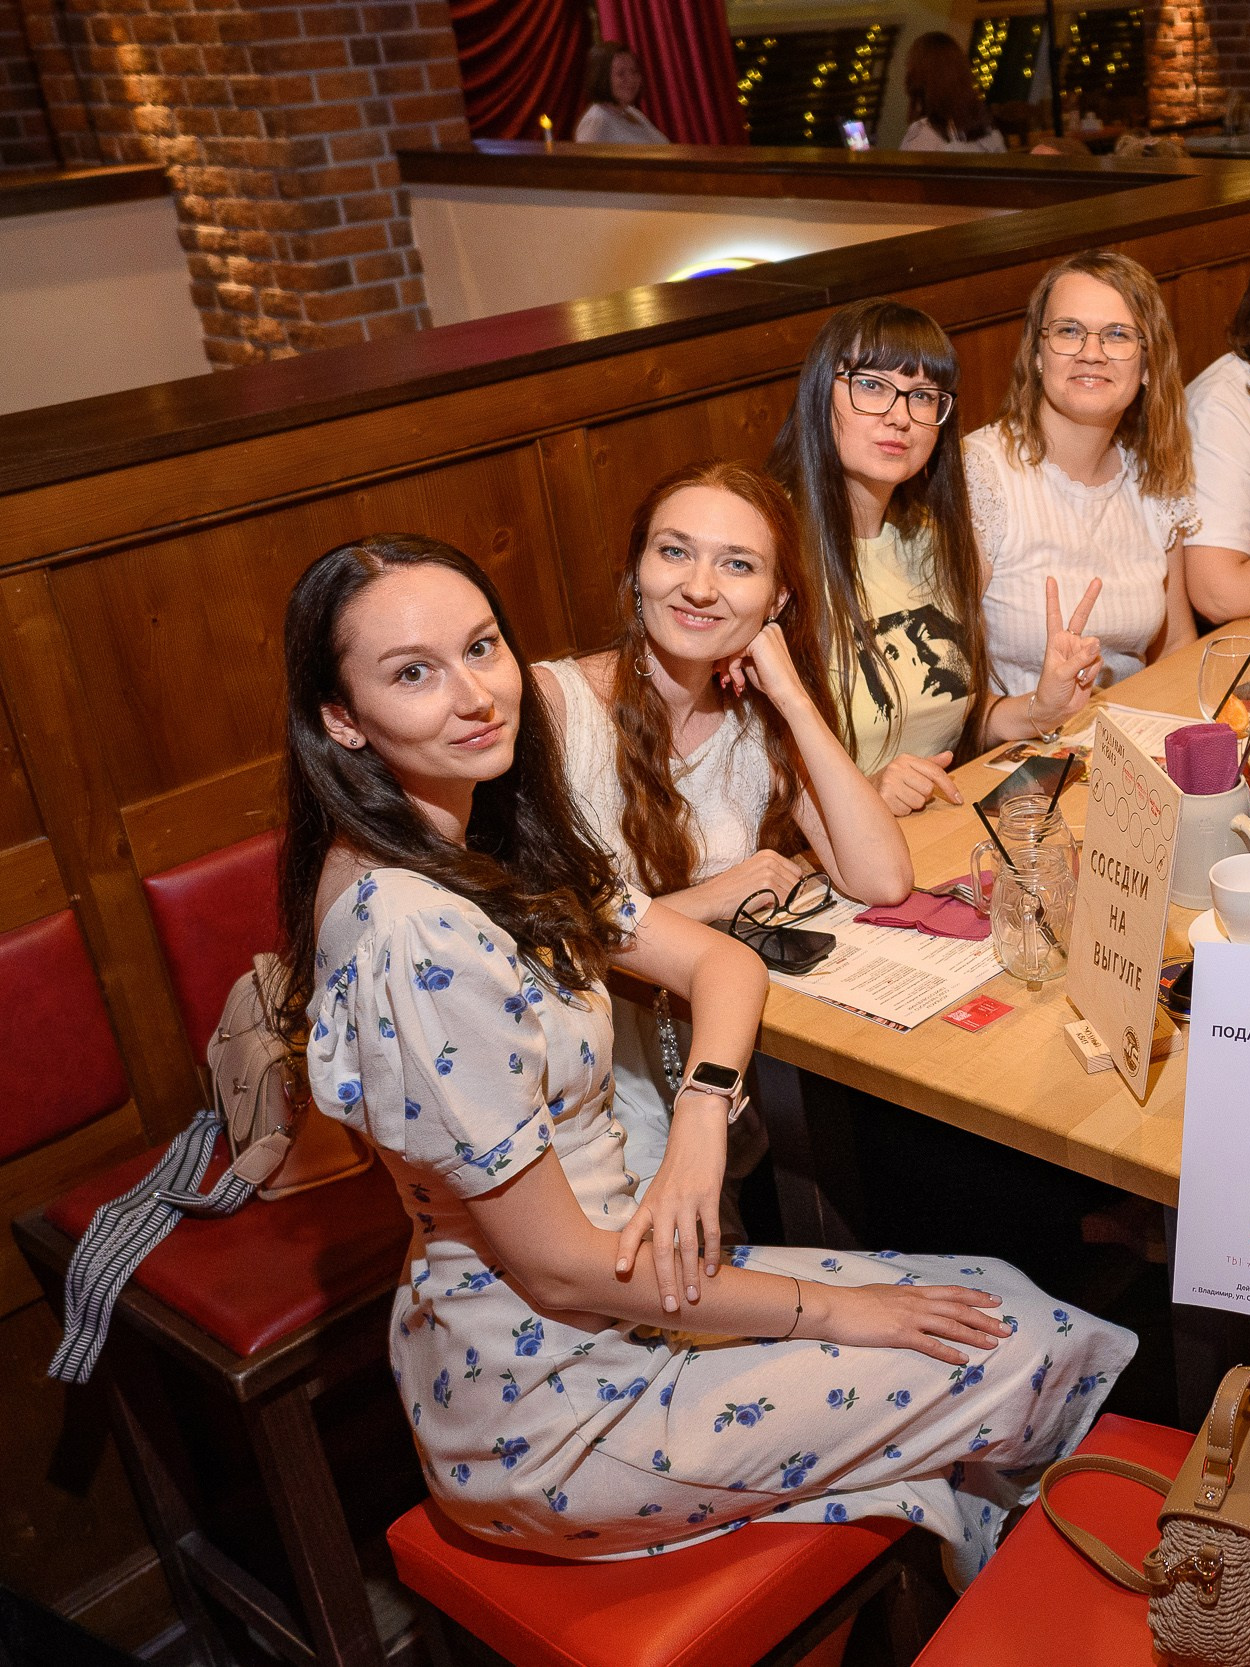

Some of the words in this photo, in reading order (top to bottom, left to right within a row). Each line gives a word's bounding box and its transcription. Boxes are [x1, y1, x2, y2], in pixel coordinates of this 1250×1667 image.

[1091, 850, 1149, 900] СОСЕДКИ
[1109, 904, 1126, 936] НА
[1094, 941, 1142, 991] ВЫГУЛЕ
[1198, 1287, 1235, 1299] Владимир,
